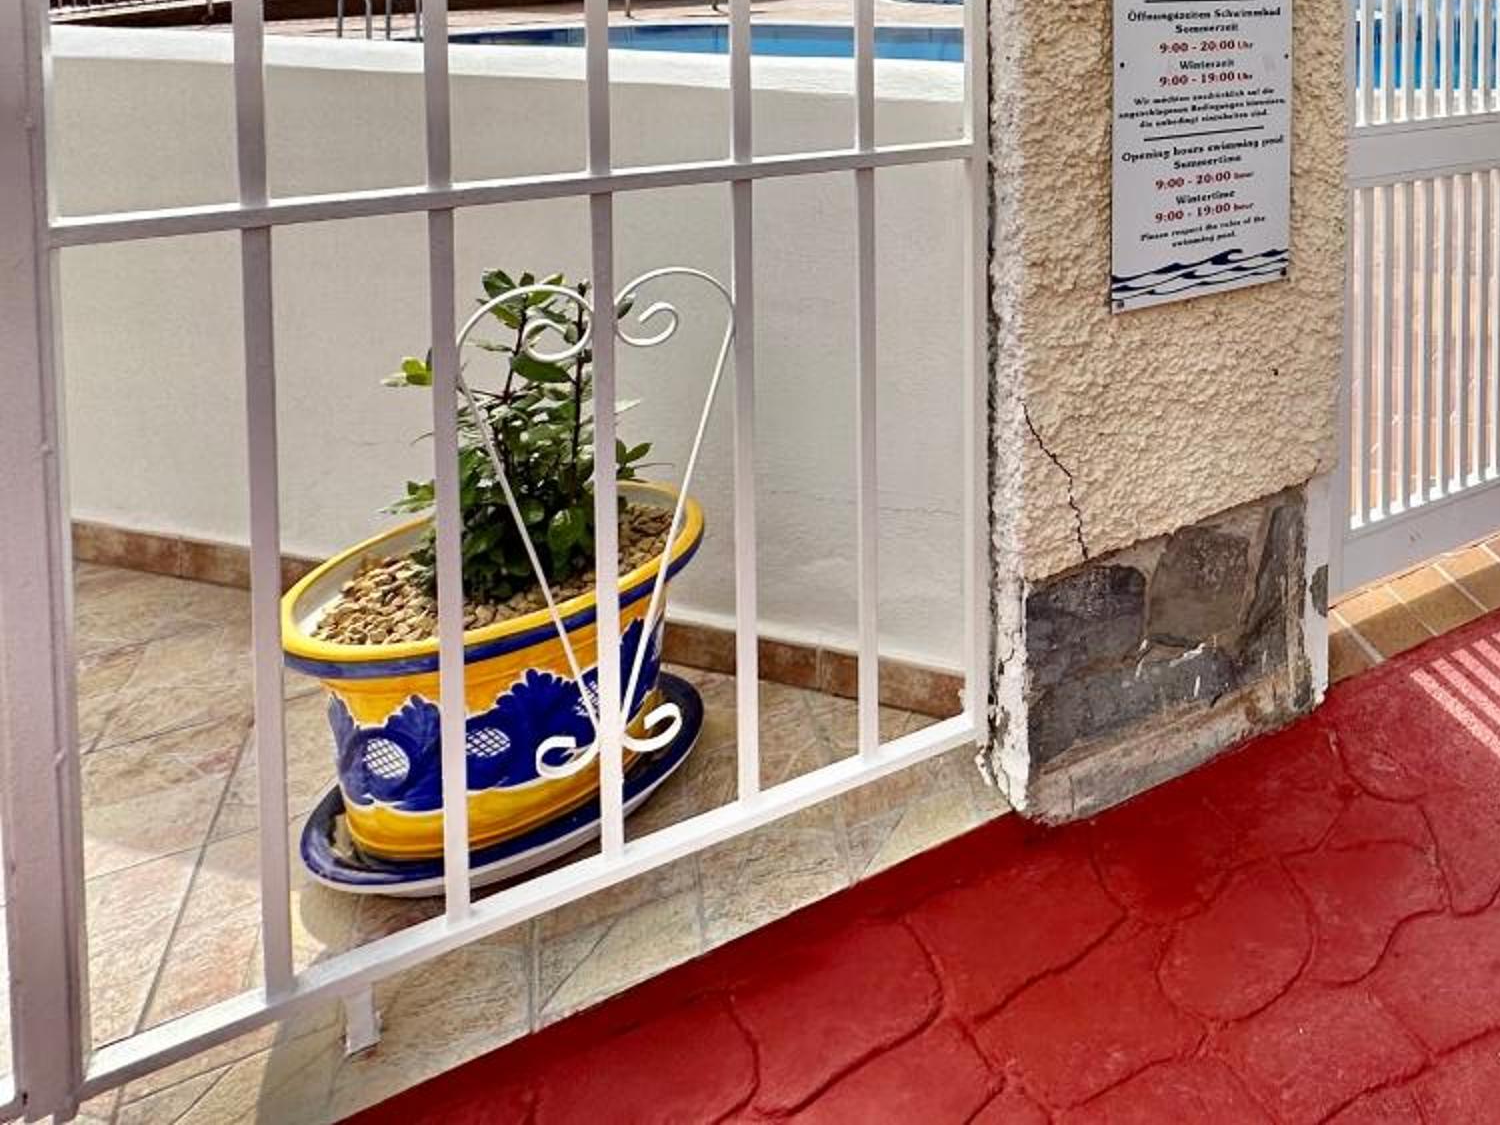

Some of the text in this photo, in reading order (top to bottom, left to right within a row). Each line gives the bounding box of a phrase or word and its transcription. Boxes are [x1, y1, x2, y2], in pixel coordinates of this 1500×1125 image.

[1159, 42, 1189, 53] 9:00
[1200, 40, 1235, 52] 20:00
[1159, 75, 1189, 86] 9:00
[1201, 71, 1235, 84] 19:00
[1121, 134, 1284, 163] Opening hours swimming pool
[1173, 154, 1242, 170] Summertime
[1155, 177, 1185, 190] 9:00
[1195, 171, 1231, 185] 20:00
[1175, 190, 1236, 205] Wintertime
[1155, 210, 1185, 223] 9:00
[1197, 203, 1231, 217] 19:00
